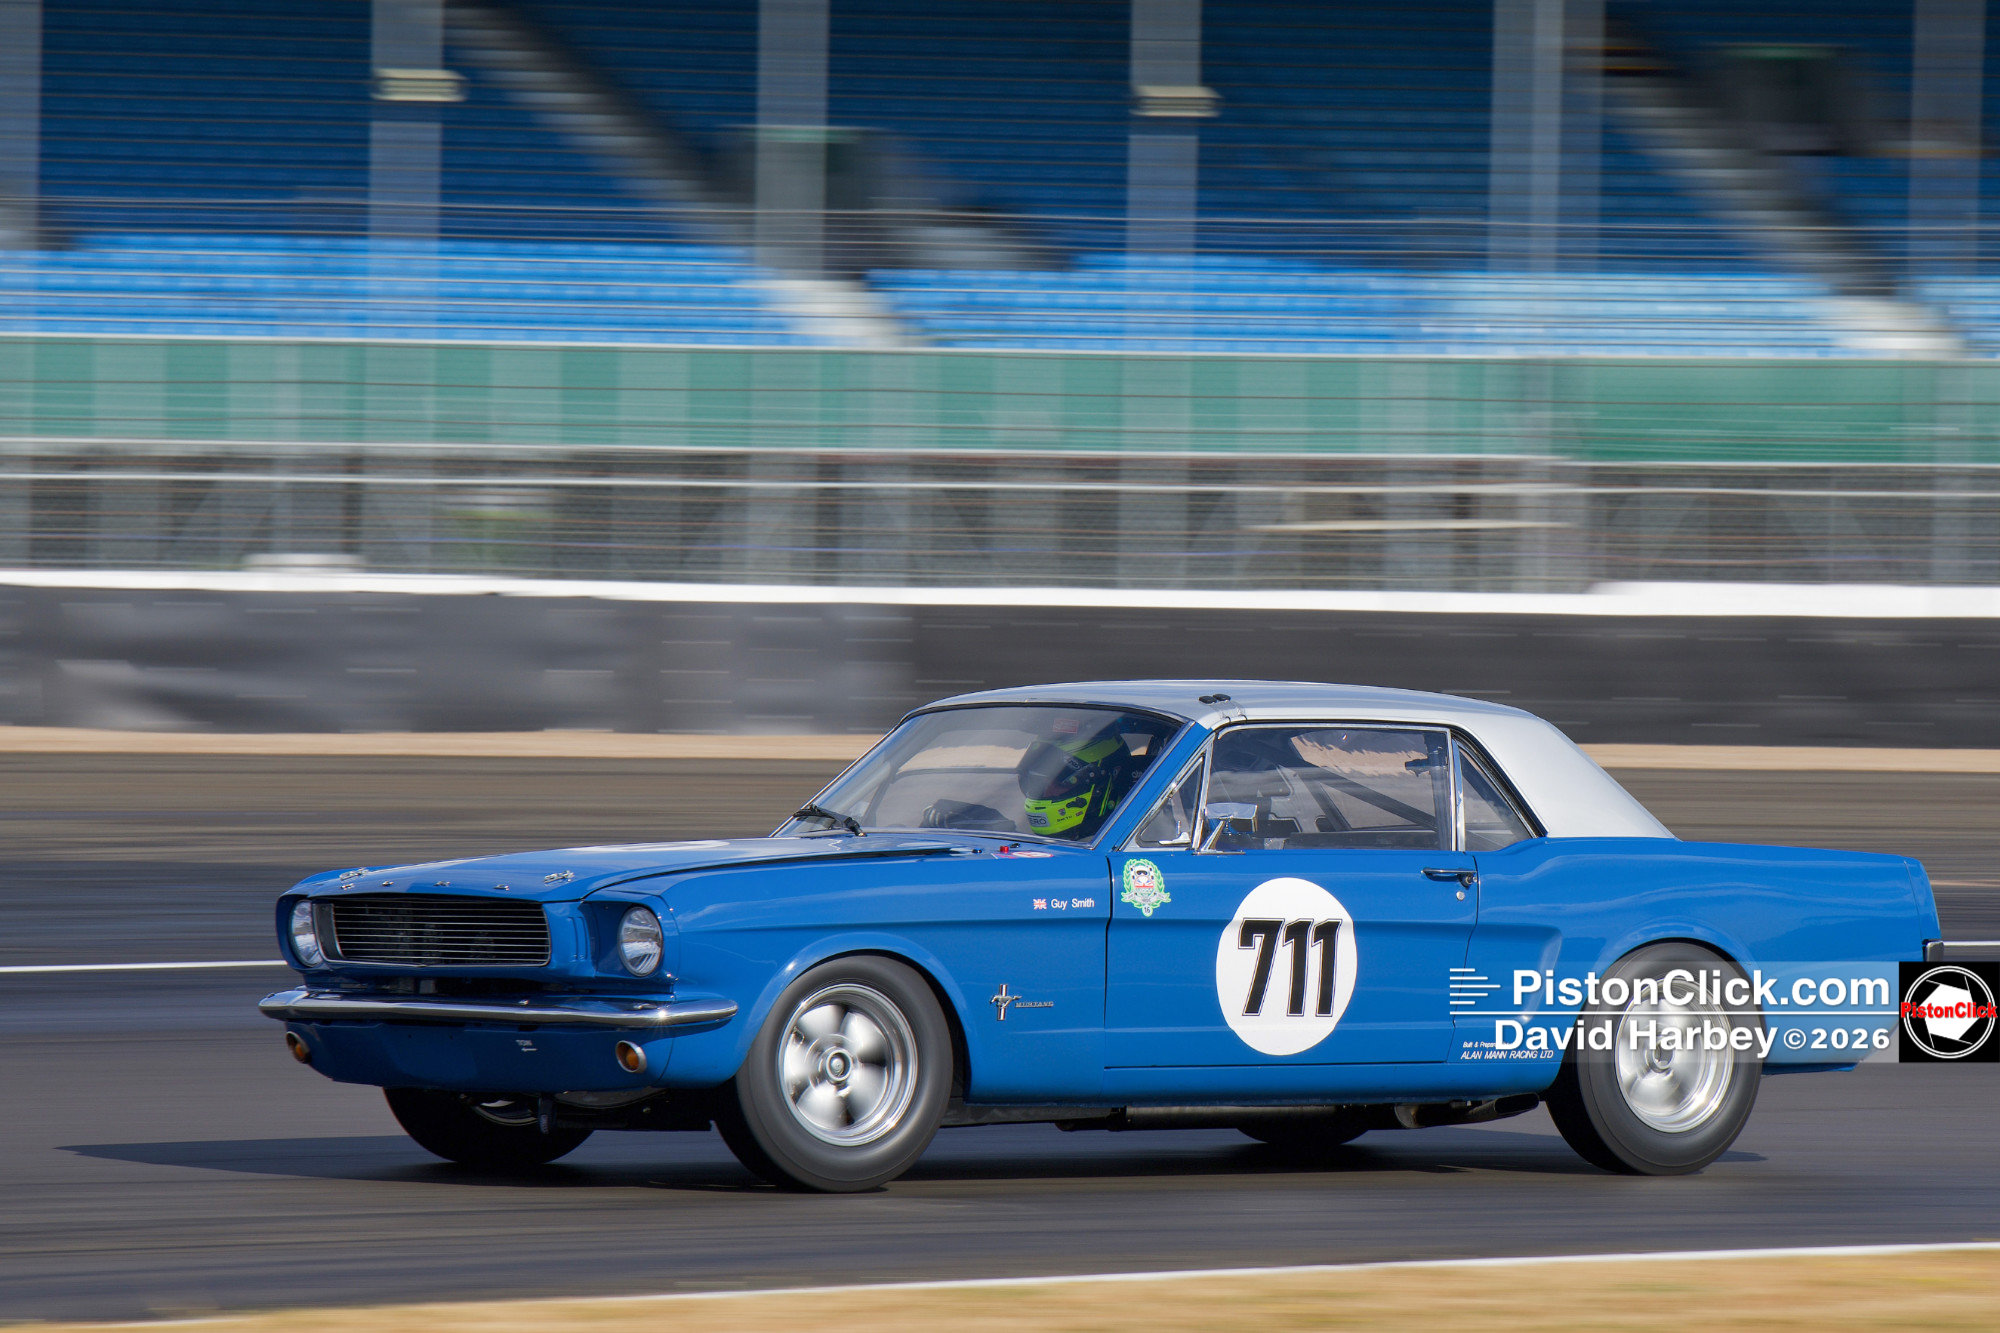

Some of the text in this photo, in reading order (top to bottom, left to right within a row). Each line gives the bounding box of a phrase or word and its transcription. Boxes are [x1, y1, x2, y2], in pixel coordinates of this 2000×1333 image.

[1051, 898, 1095, 910] Guy Smith
[1238, 917, 1343, 1017] 711
[1461, 1050, 1553, 1060] ALAN MANN RACING LTD
